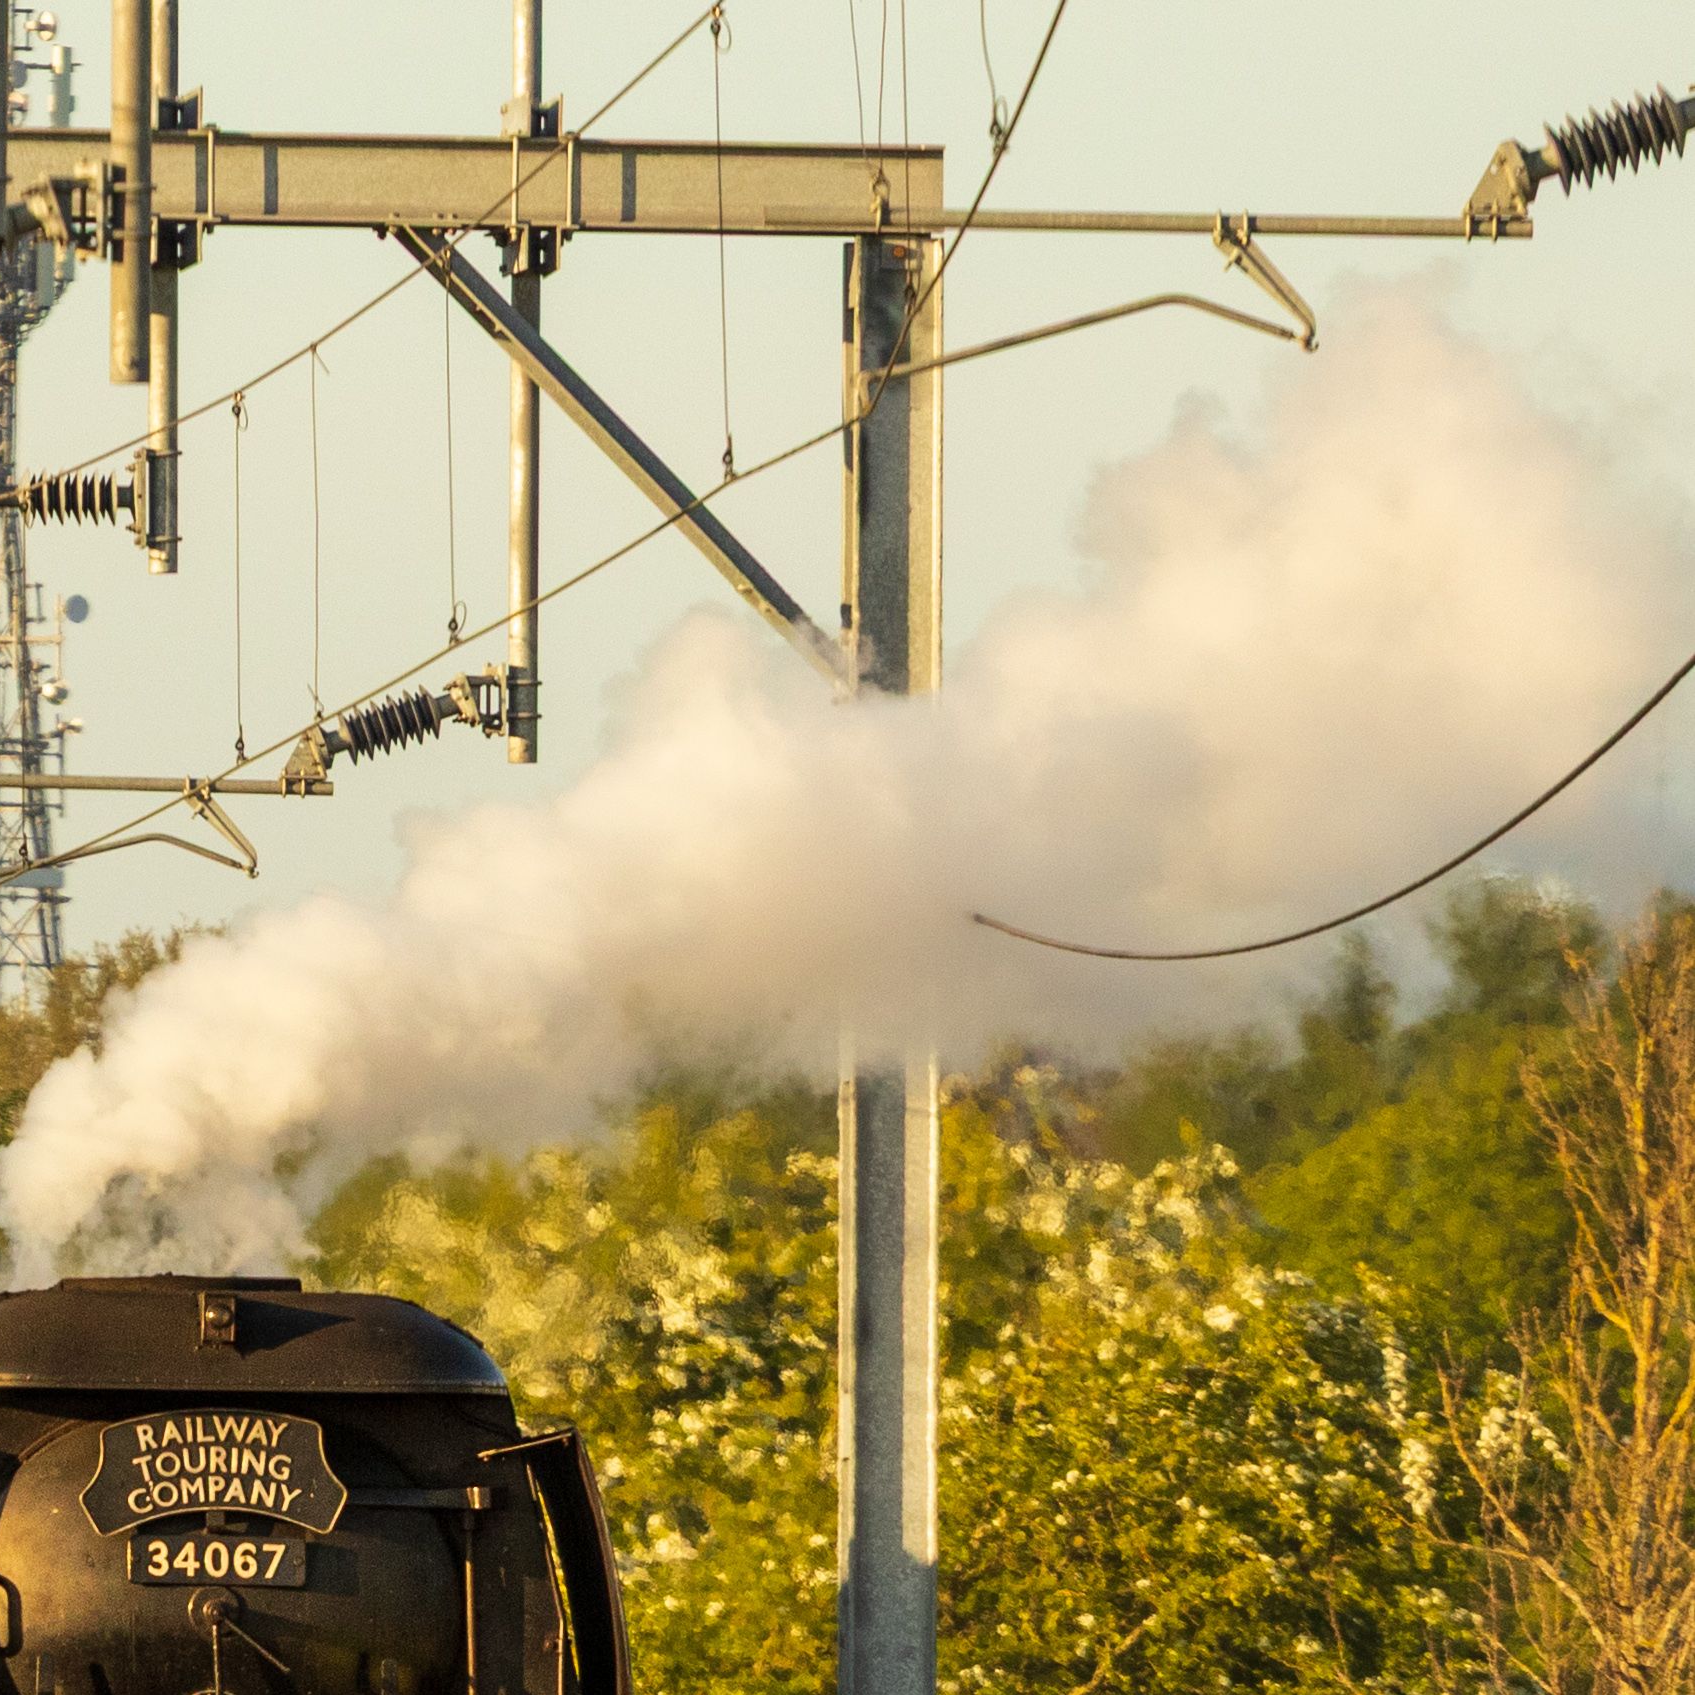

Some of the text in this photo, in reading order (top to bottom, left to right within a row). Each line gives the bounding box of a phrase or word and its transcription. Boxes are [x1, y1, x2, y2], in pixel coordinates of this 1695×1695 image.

[135, 1415, 288, 1452] RAILWAY
[132, 1446, 292, 1482] TOURING
[128, 1475, 302, 1513] COMPANY
[147, 1540, 286, 1579] 34067
